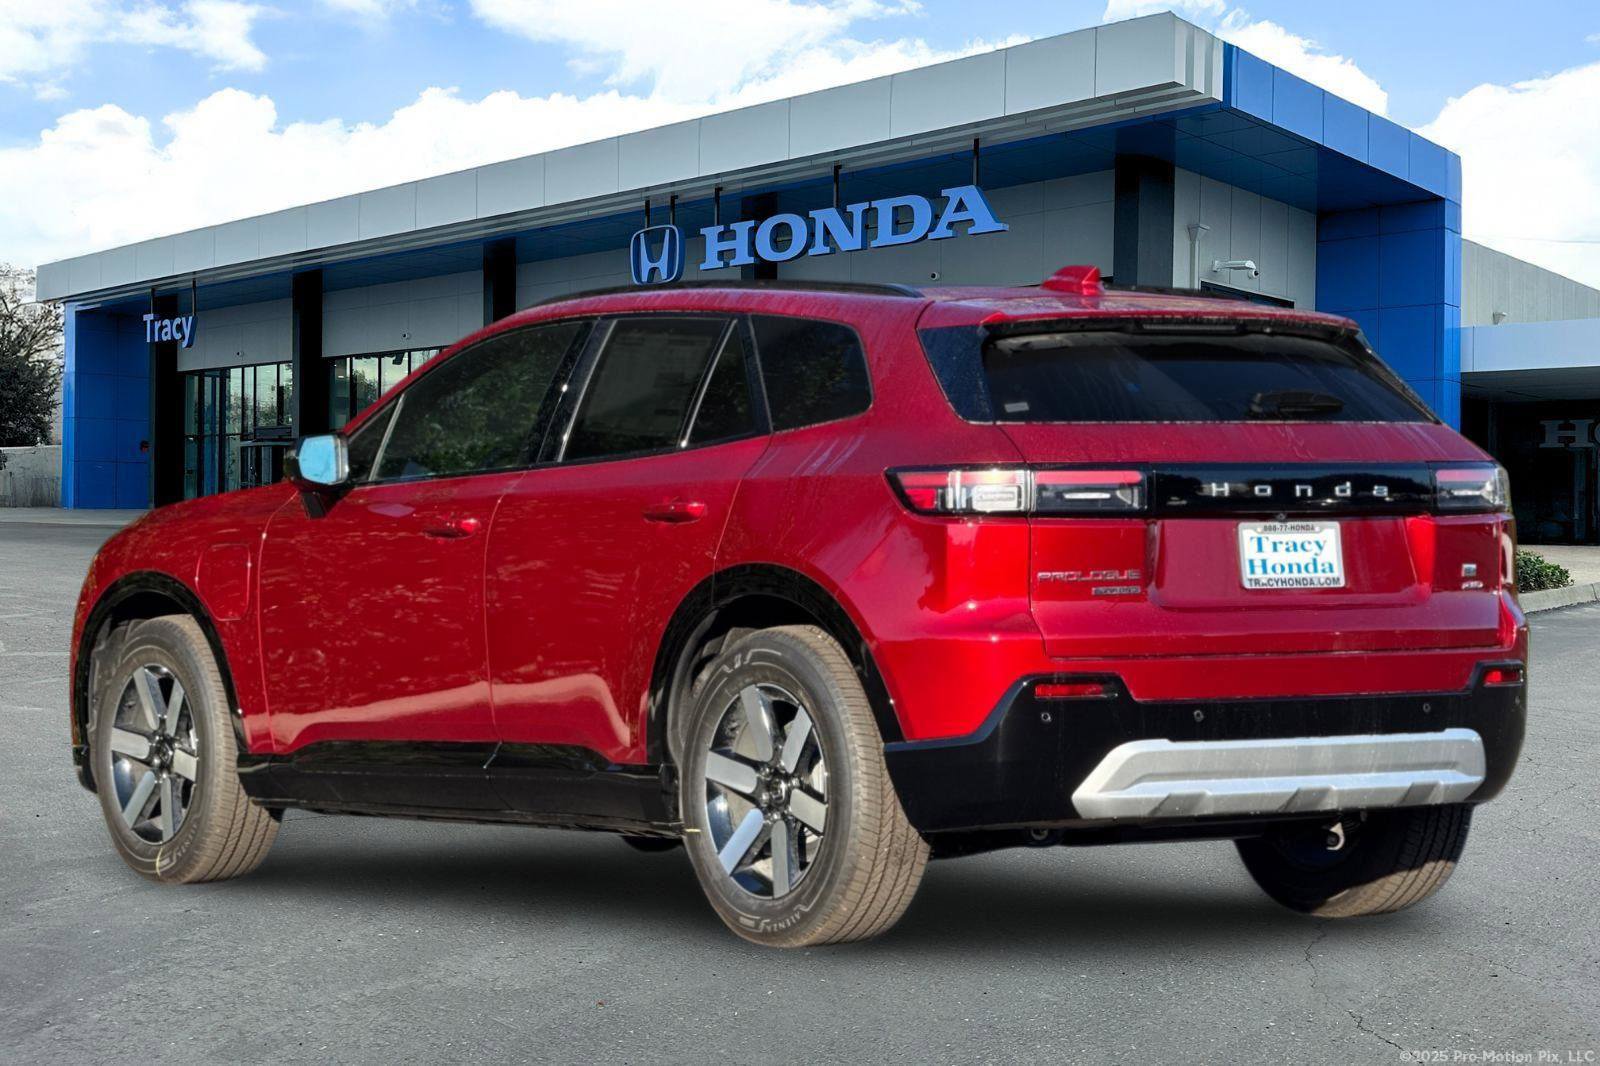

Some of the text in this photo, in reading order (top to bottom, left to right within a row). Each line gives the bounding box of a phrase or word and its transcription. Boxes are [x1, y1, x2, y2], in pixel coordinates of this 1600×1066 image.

[699, 184, 1010, 271] HONDA
[142, 313, 195, 348] Tracy
[1539, 418, 1600, 448] H
[1211, 481, 1388, 498] Honda
[1249, 535, 1327, 557] Tracy
[1037, 569, 1141, 582] PROLOGUE
[1247, 557, 1335, 576] Honda
